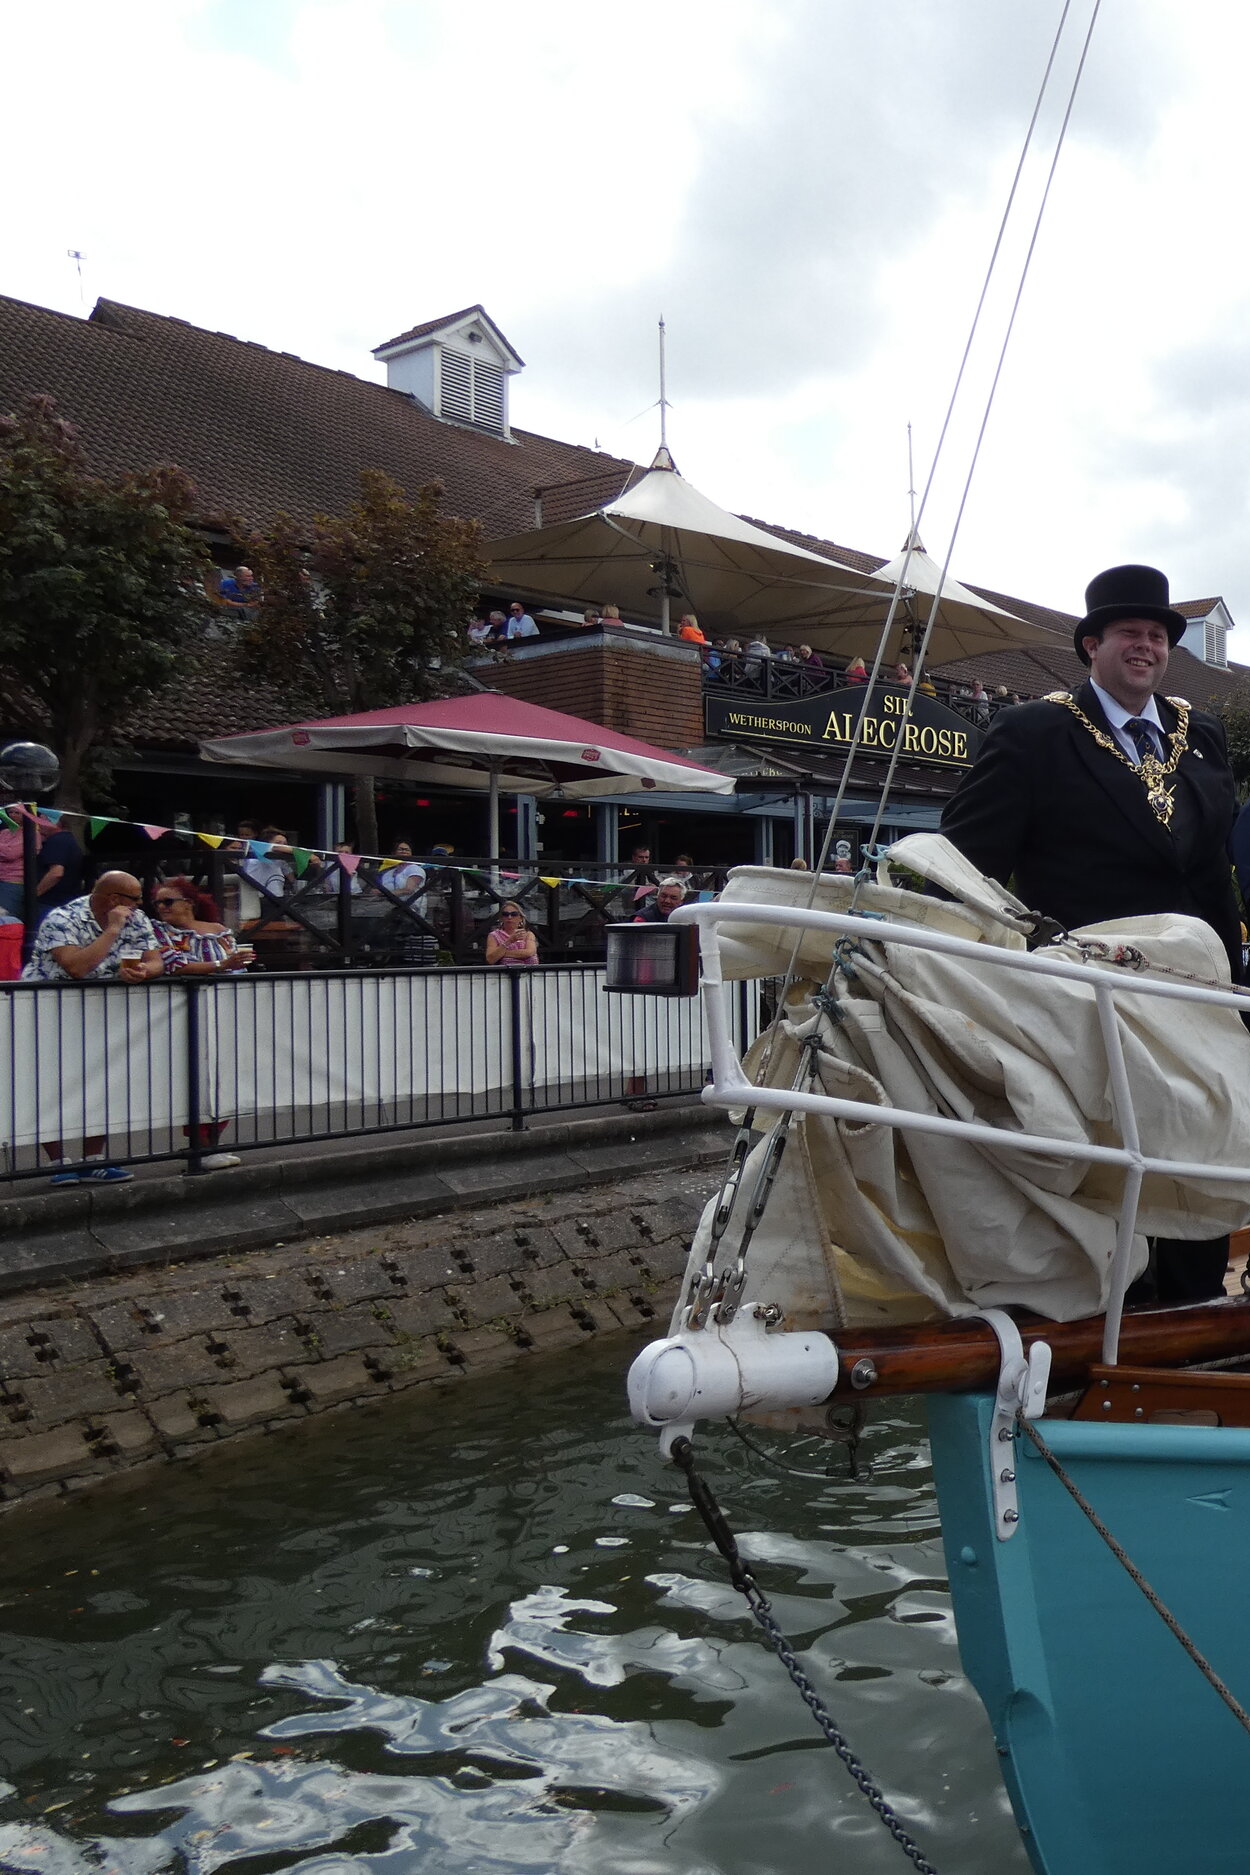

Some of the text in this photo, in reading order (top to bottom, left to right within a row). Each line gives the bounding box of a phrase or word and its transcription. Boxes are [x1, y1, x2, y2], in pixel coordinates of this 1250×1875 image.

[728, 712, 812, 735] WETHERSPOON
[822, 711, 968, 759] ALEC ROSE
